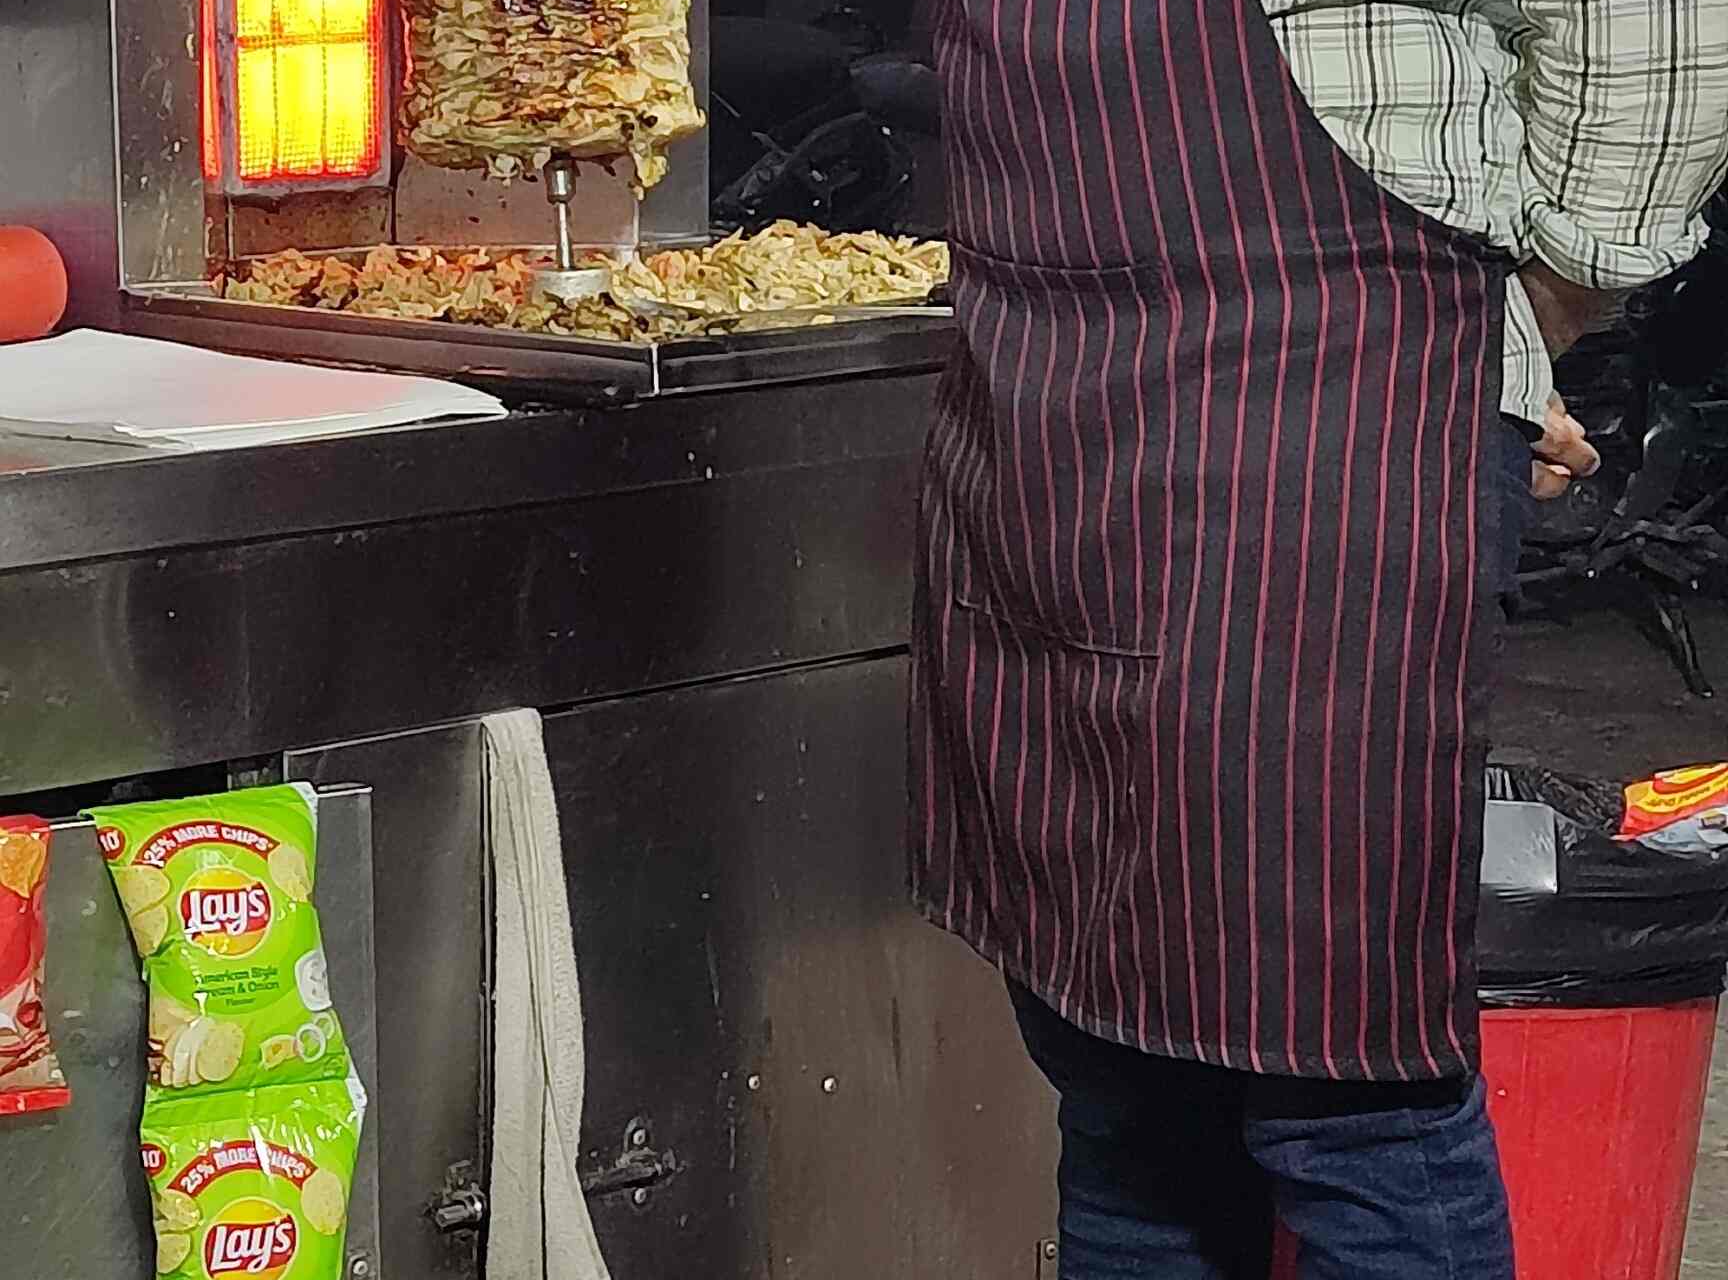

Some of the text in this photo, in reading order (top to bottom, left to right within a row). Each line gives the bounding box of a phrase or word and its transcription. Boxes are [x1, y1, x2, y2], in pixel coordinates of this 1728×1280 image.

[172, 825, 219, 843] MORE
[184, 886, 266, 936] Lay's
[180, 1163, 215, 1193] 25%
[213, 1147, 257, 1169] MORE
[210, 1219, 292, 1272] Lay's
